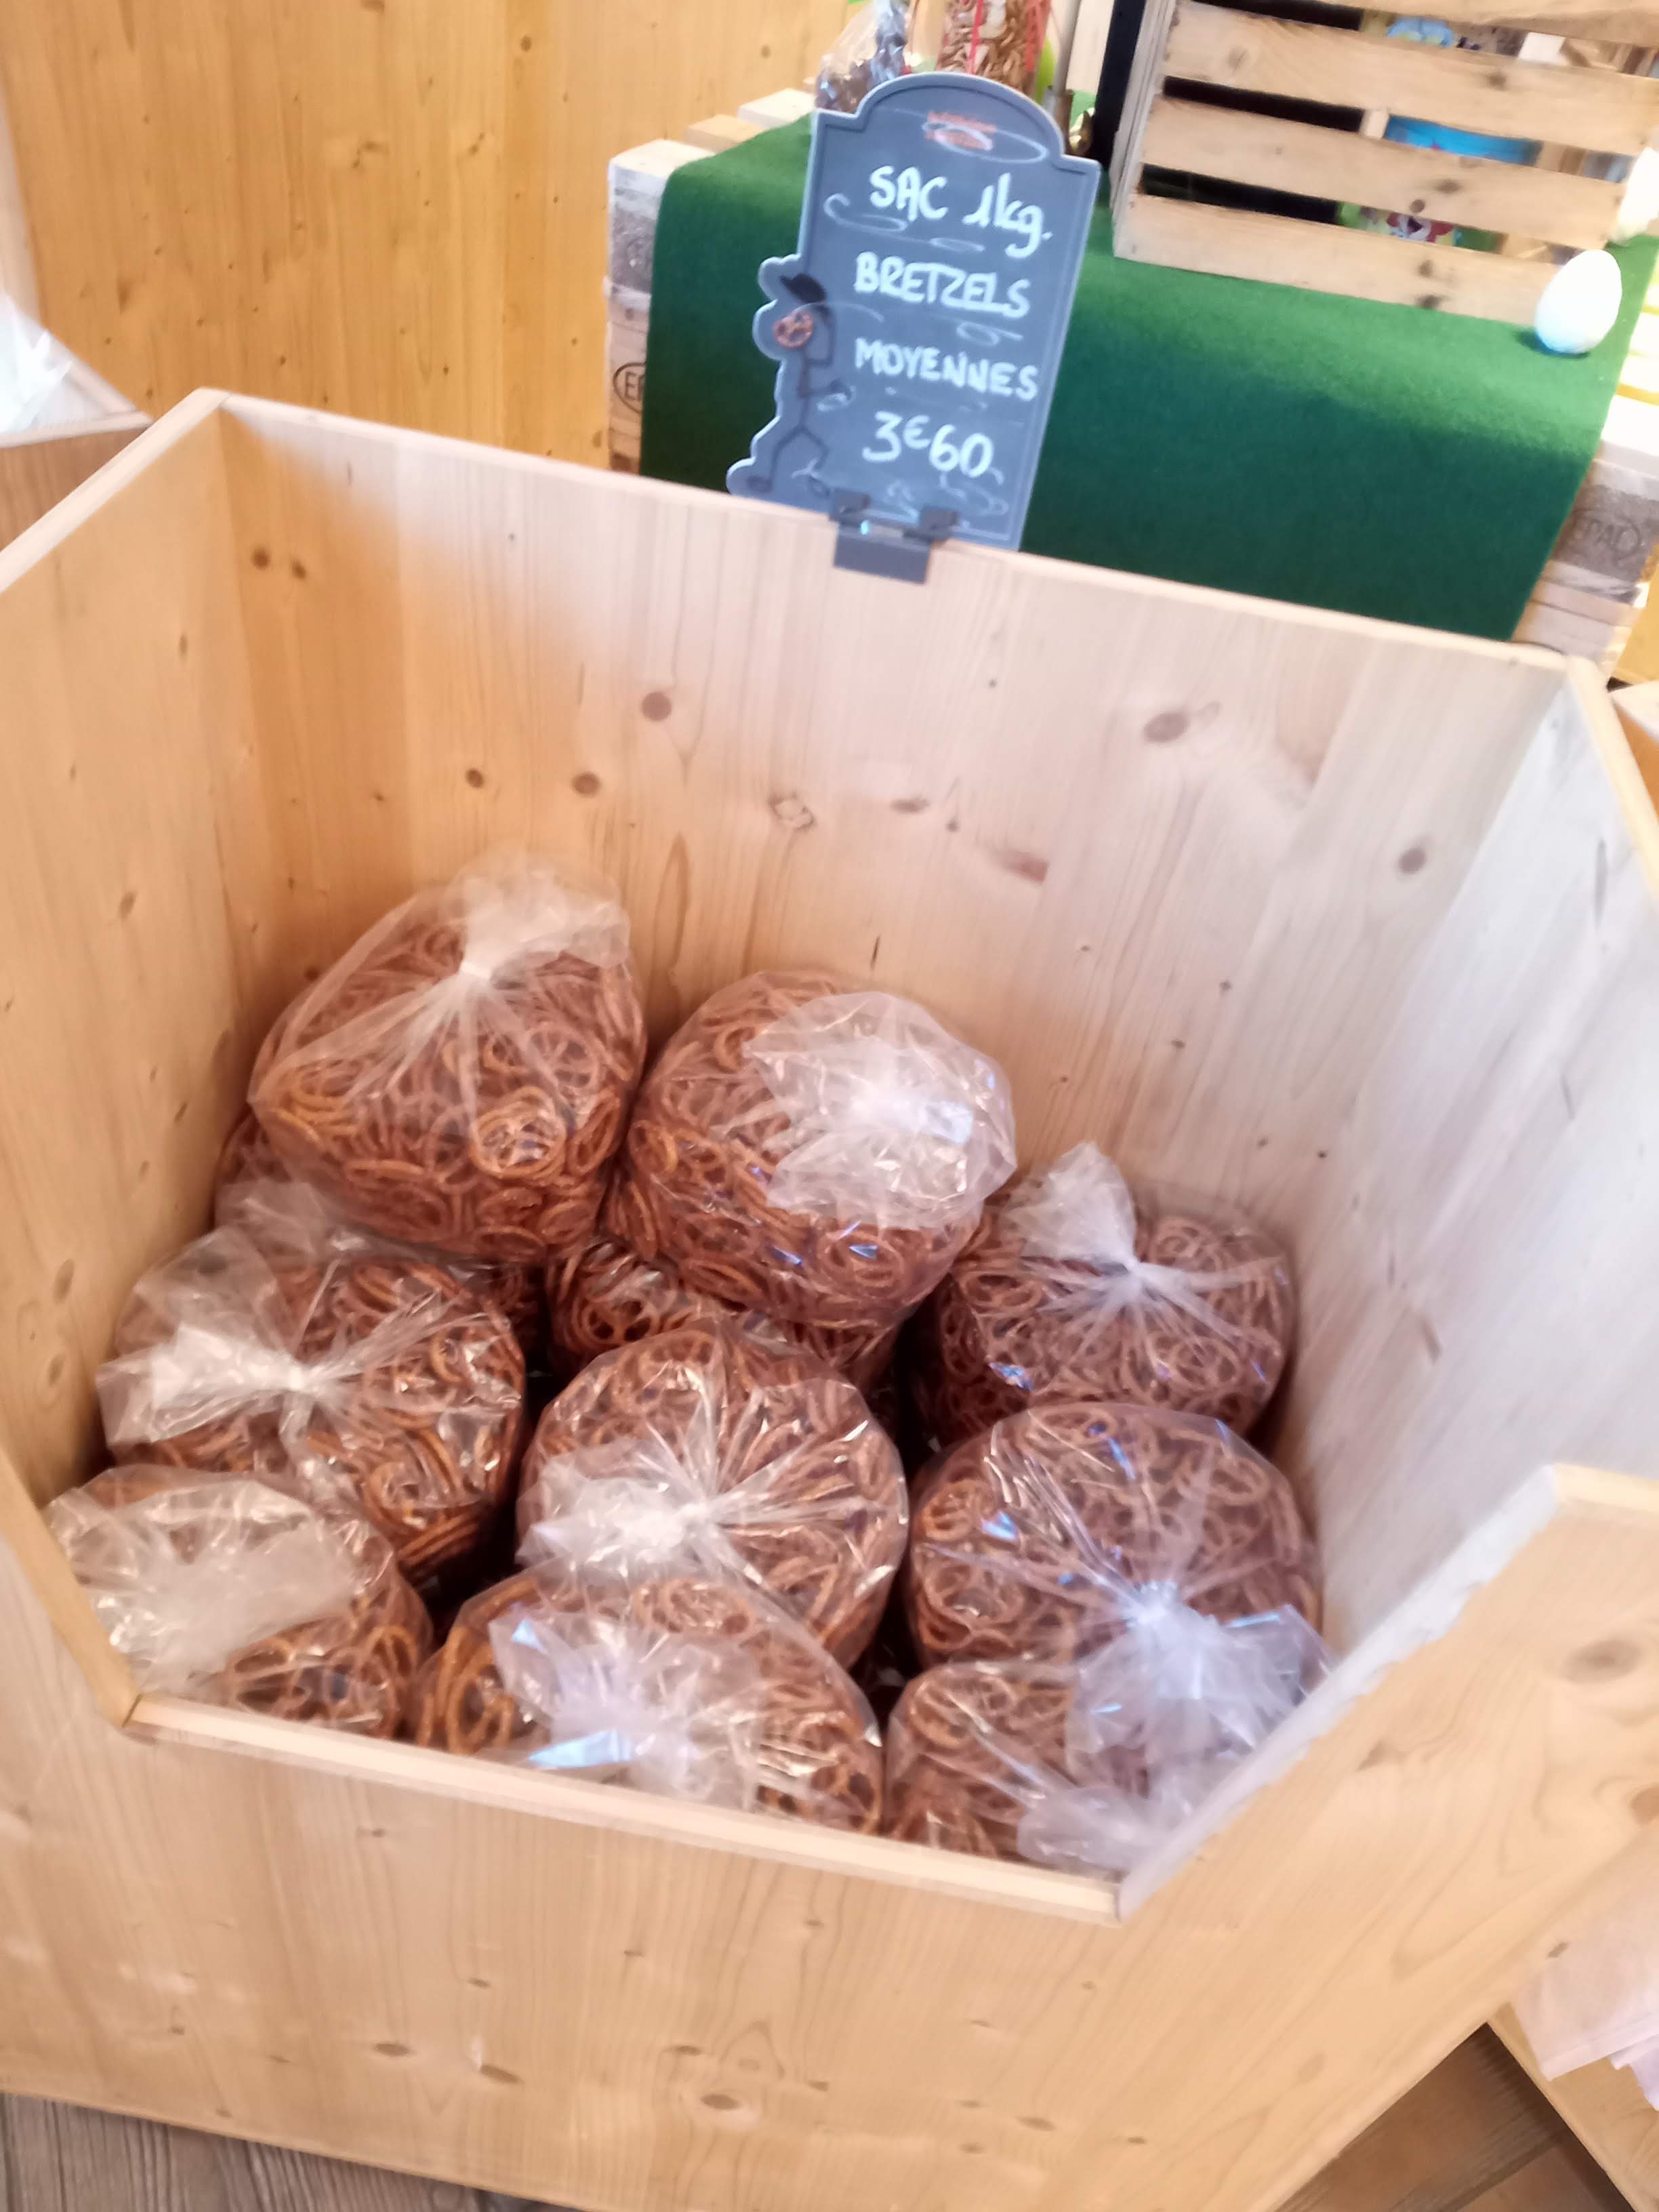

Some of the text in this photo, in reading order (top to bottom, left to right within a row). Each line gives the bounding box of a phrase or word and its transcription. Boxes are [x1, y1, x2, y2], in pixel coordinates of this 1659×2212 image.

[869, 165, 949, 222] SAC
[854, 251, 1029, 319] BRETZELS
[855, 337, 1040, 401] MOYENNES
